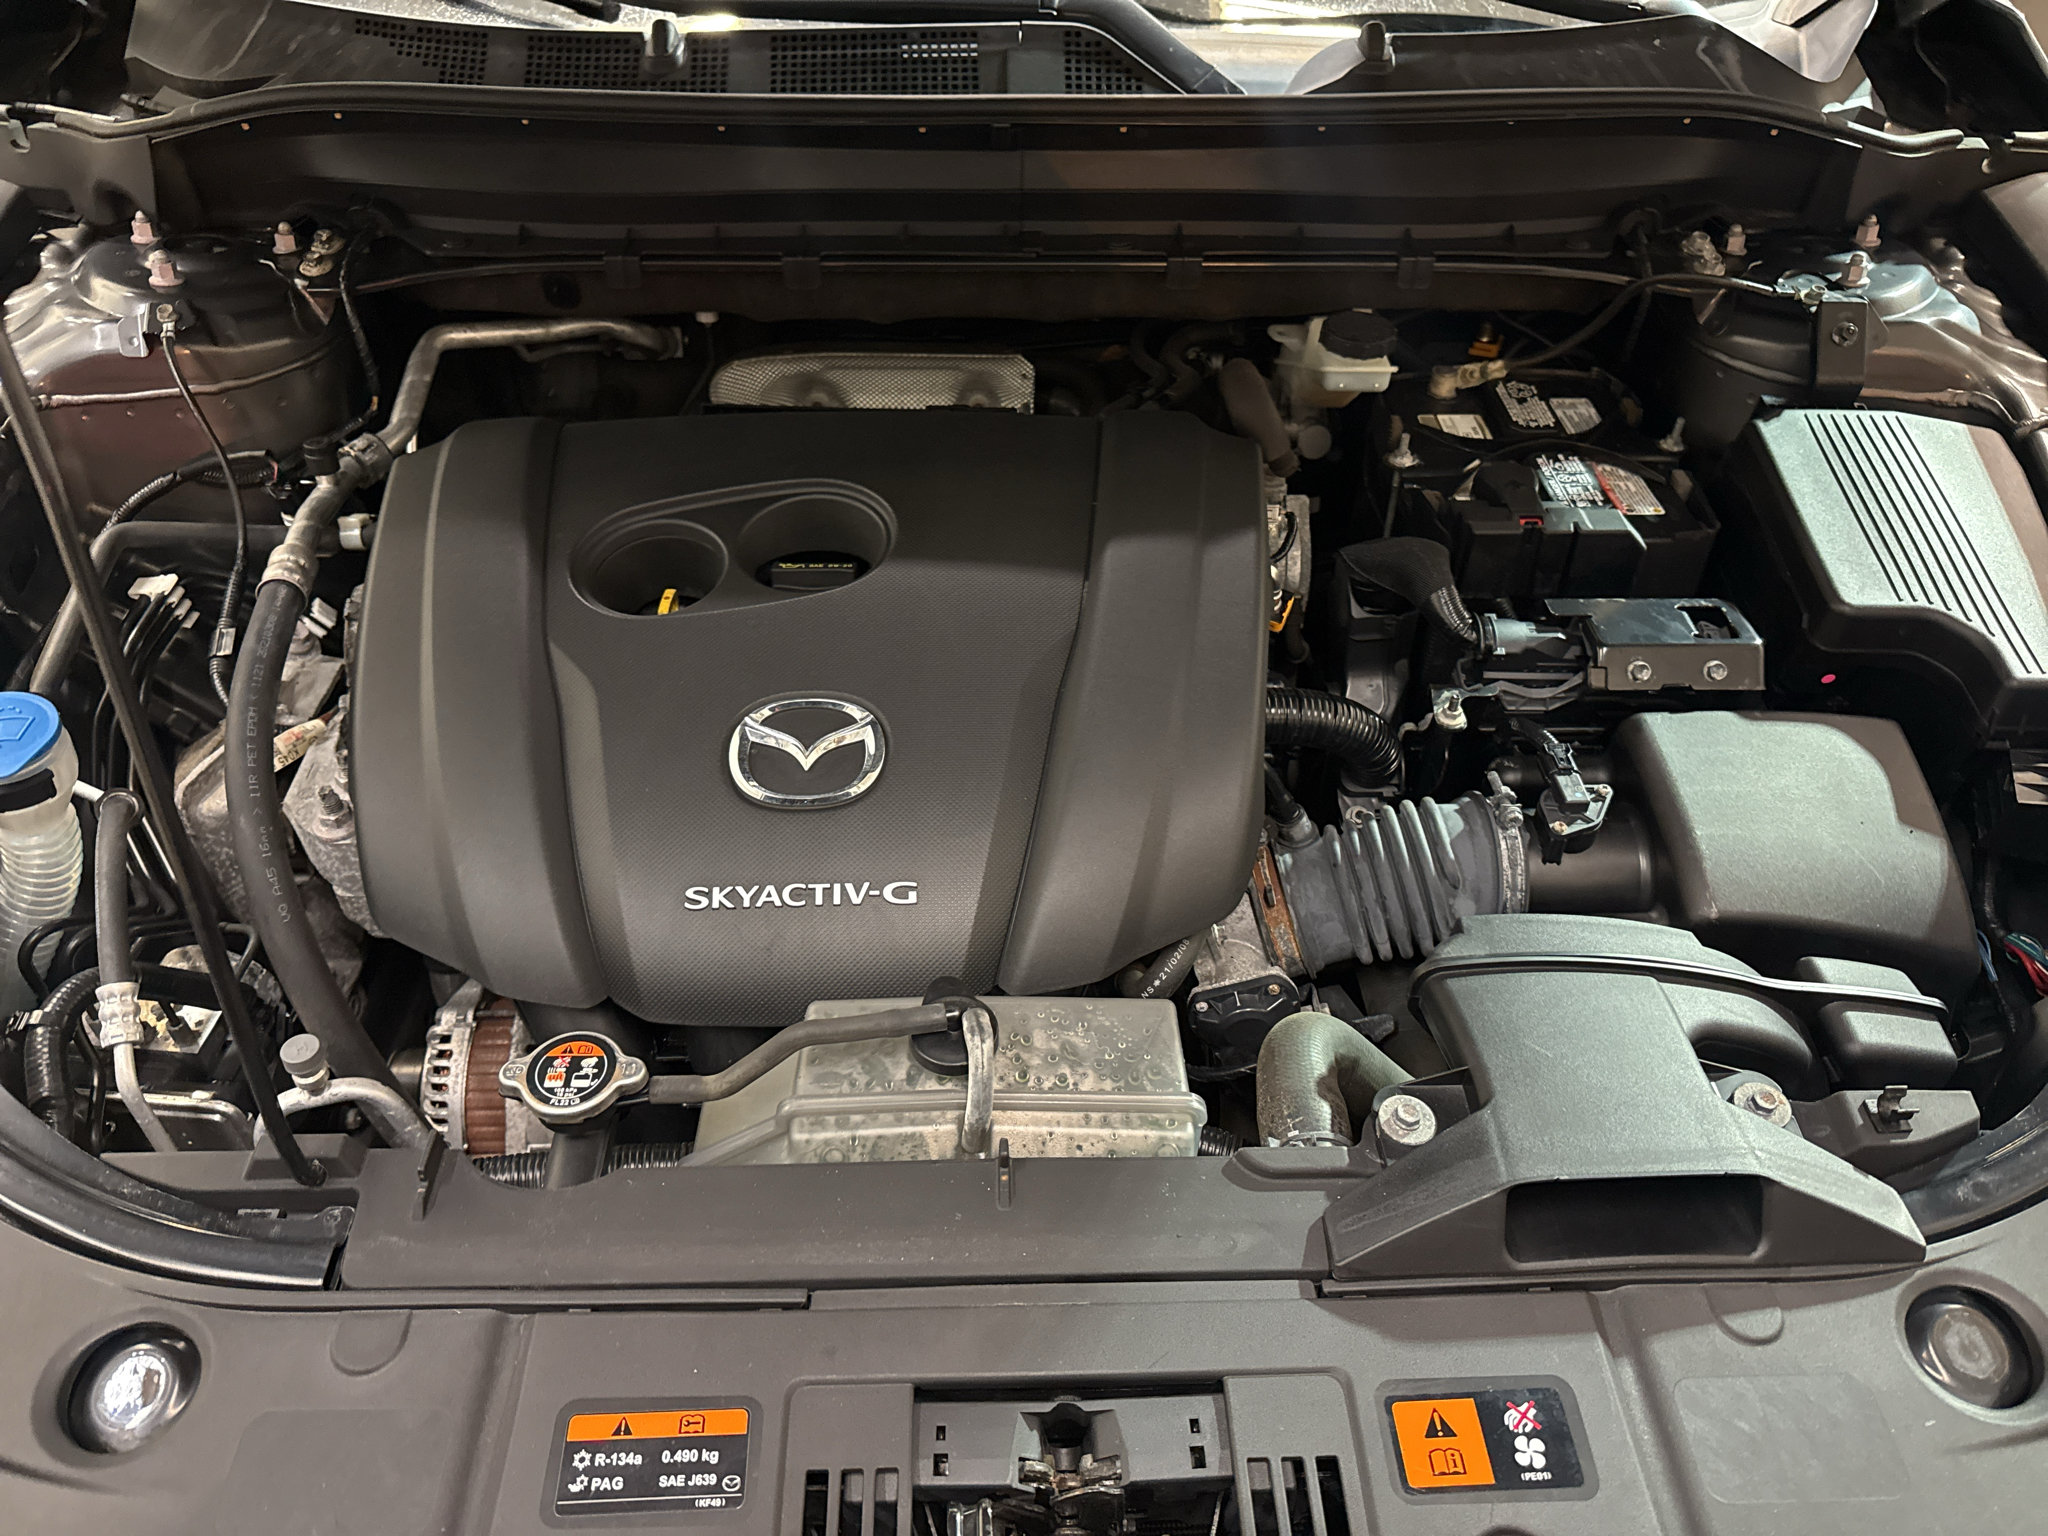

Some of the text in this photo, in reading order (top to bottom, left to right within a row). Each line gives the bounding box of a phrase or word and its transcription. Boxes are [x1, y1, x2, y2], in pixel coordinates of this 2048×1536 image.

[247, 743, 257, 767] PET
[266, 867, 283, 896] A45
[684, 881, 918, 910] SKYACTIV-G
[594, 1448, 719, 1466] R-134a 0.490 kg
[590, 1473, 717, 1491] PAG SAE J639
[1520, 1471, 1552, 1481] (PE01)
[695, 1498, 726, 1508] (KF49)
